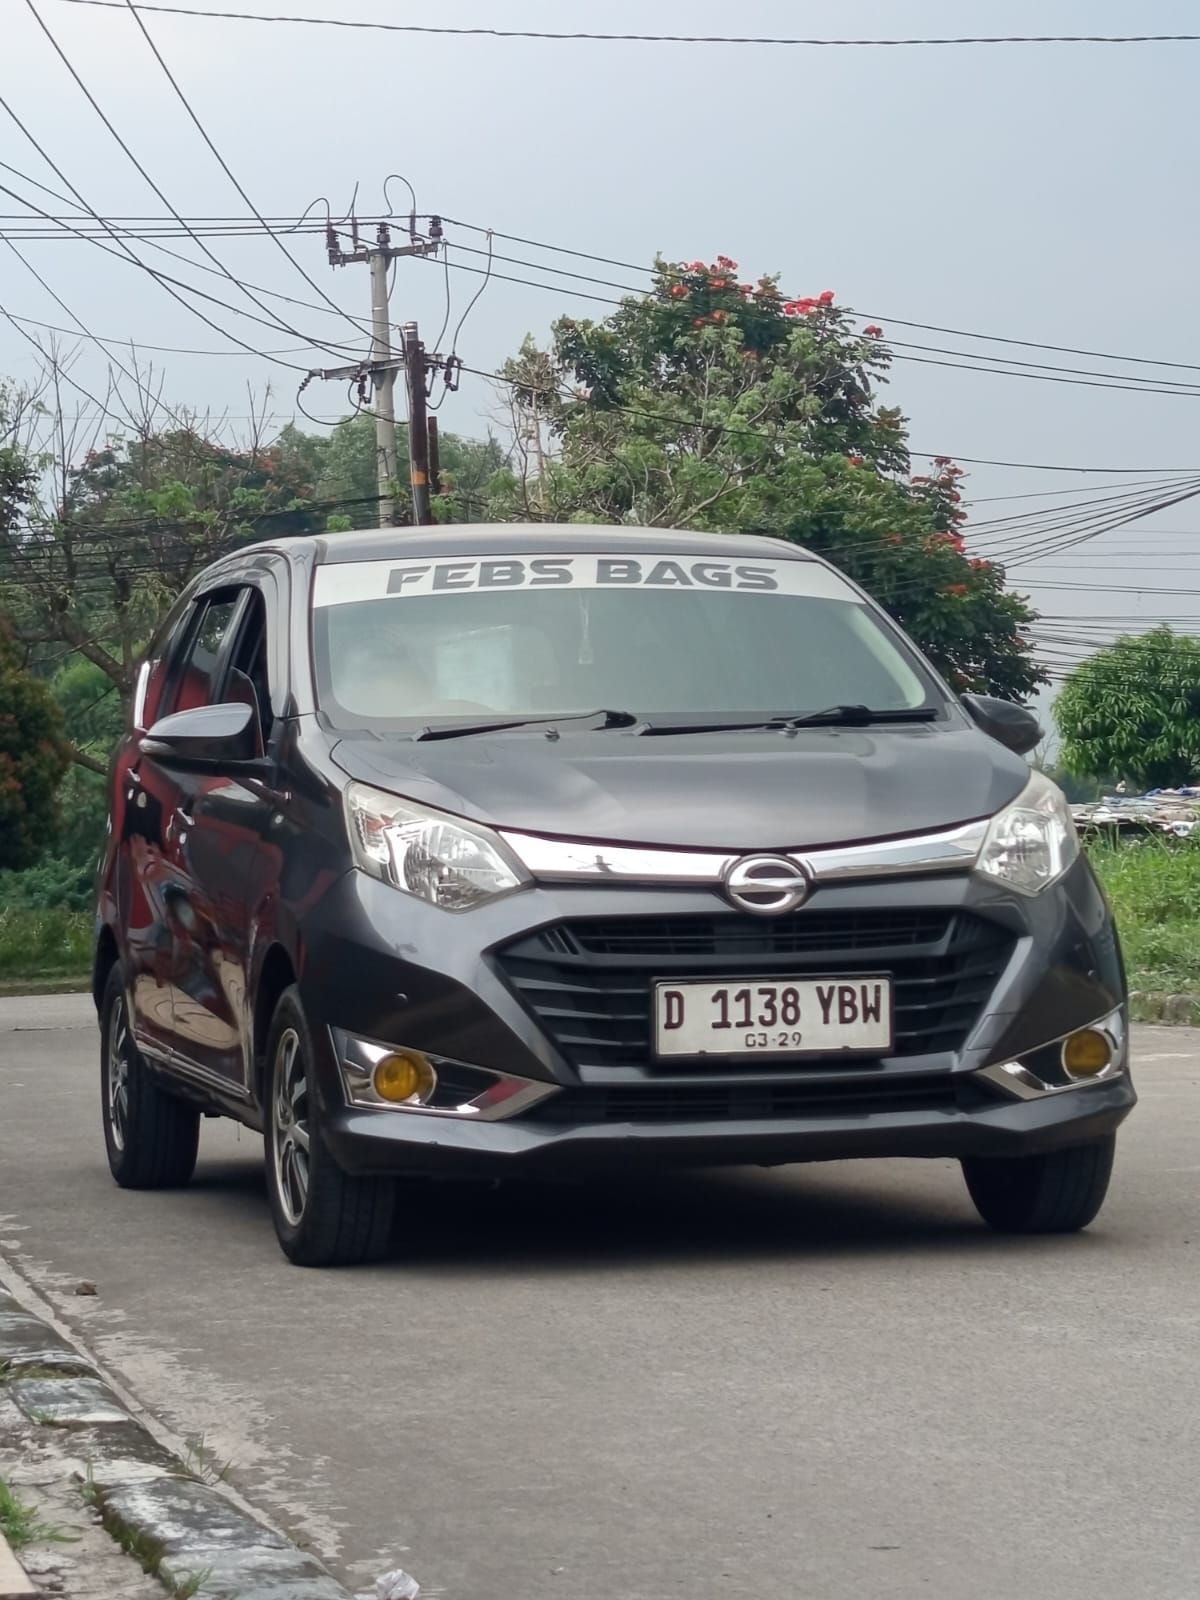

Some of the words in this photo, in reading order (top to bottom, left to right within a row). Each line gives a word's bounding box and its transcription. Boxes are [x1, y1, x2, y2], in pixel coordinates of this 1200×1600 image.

[387, 559, 575, 594] FEBS
[596, 560, 778, 590] BAGS
[663, 990, 684, 1029] D
[711, 987, 800, 1029] 1138
[816, 984, 881, 1024] YBW
